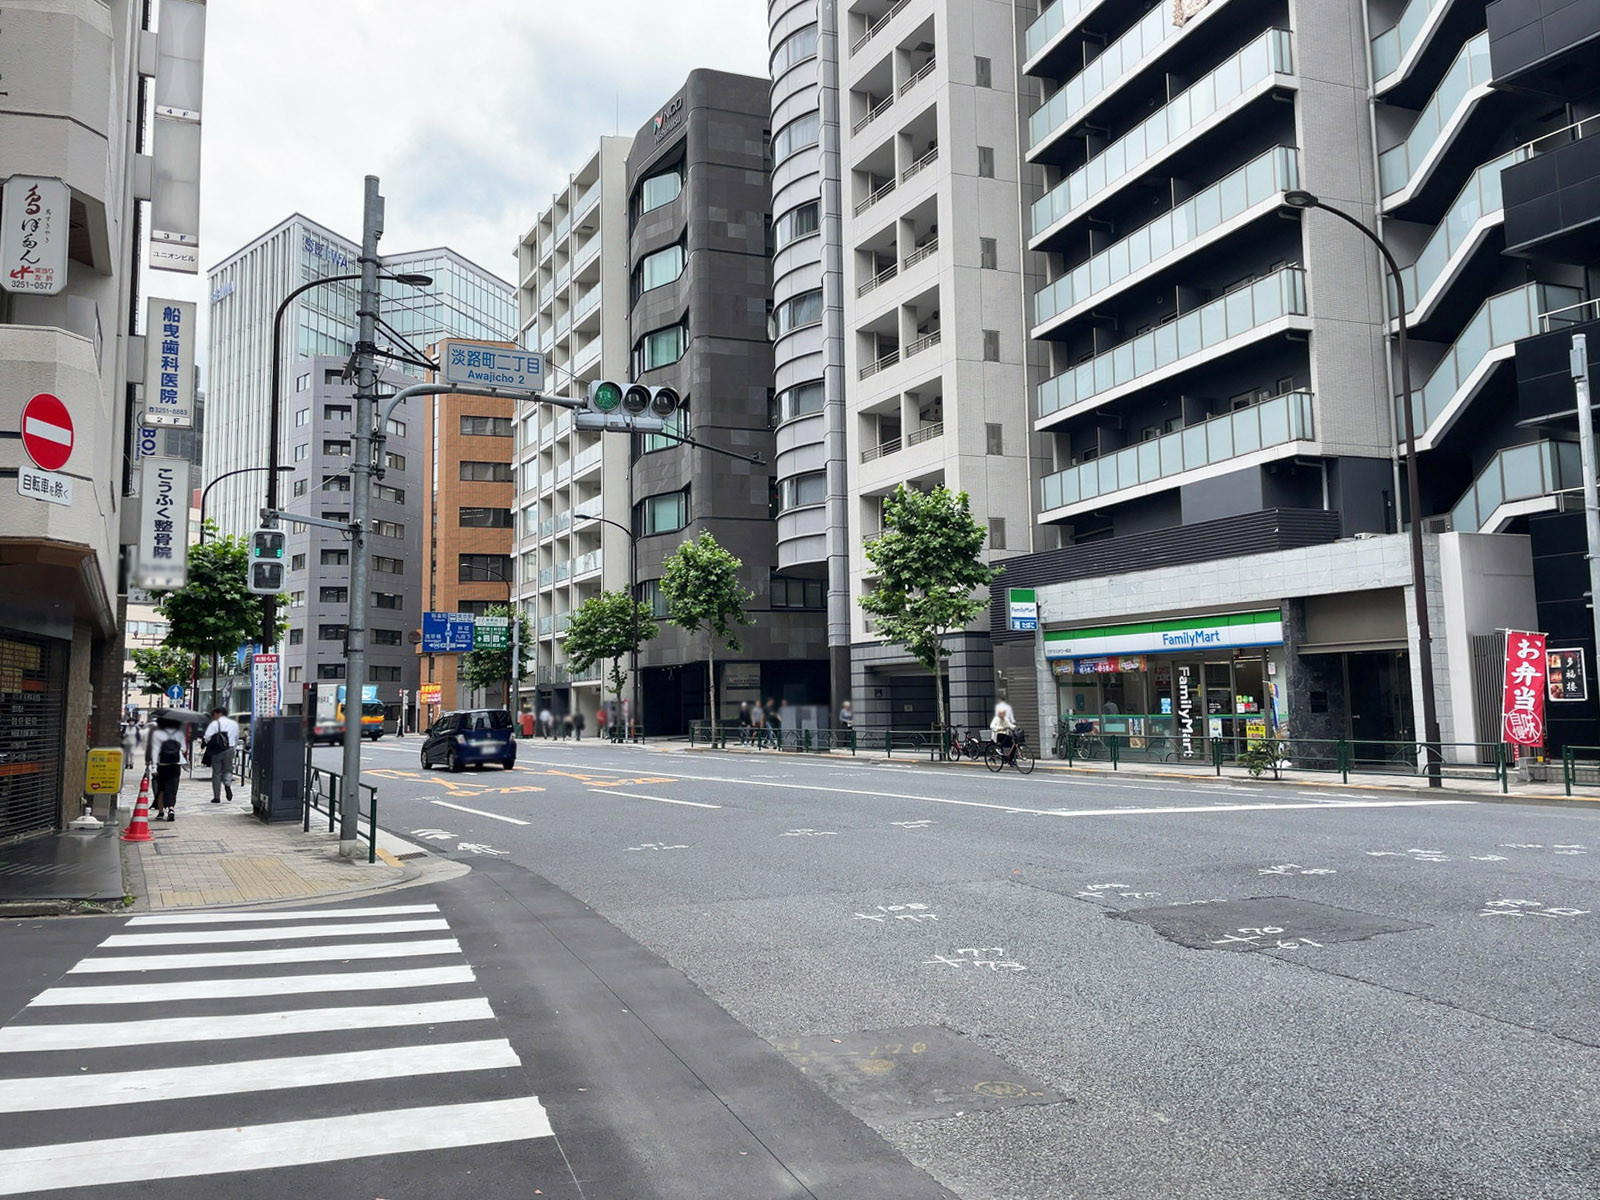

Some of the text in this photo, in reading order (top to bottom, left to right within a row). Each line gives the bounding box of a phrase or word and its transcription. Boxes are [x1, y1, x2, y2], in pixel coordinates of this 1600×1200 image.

[152, 251, 196, 262] ユニオンビル
[11, 280, 54, 290] 3251-0577
[160, 306, 182, 405] 船曳歯科医院
[451, 348, 540, 375] 淡路町二丁目
[468, 370, 525, 384] Awajicho 2
[22, 473, 69, 500] 自転車を除く
[153, 468, 173, 560] こうふく整骨院
[1162, 630, 1221, 647] FamilyMart
[1510, 638, 1542, 712] お弁当
[1178, 666, 1194, 758] FamilyMart
